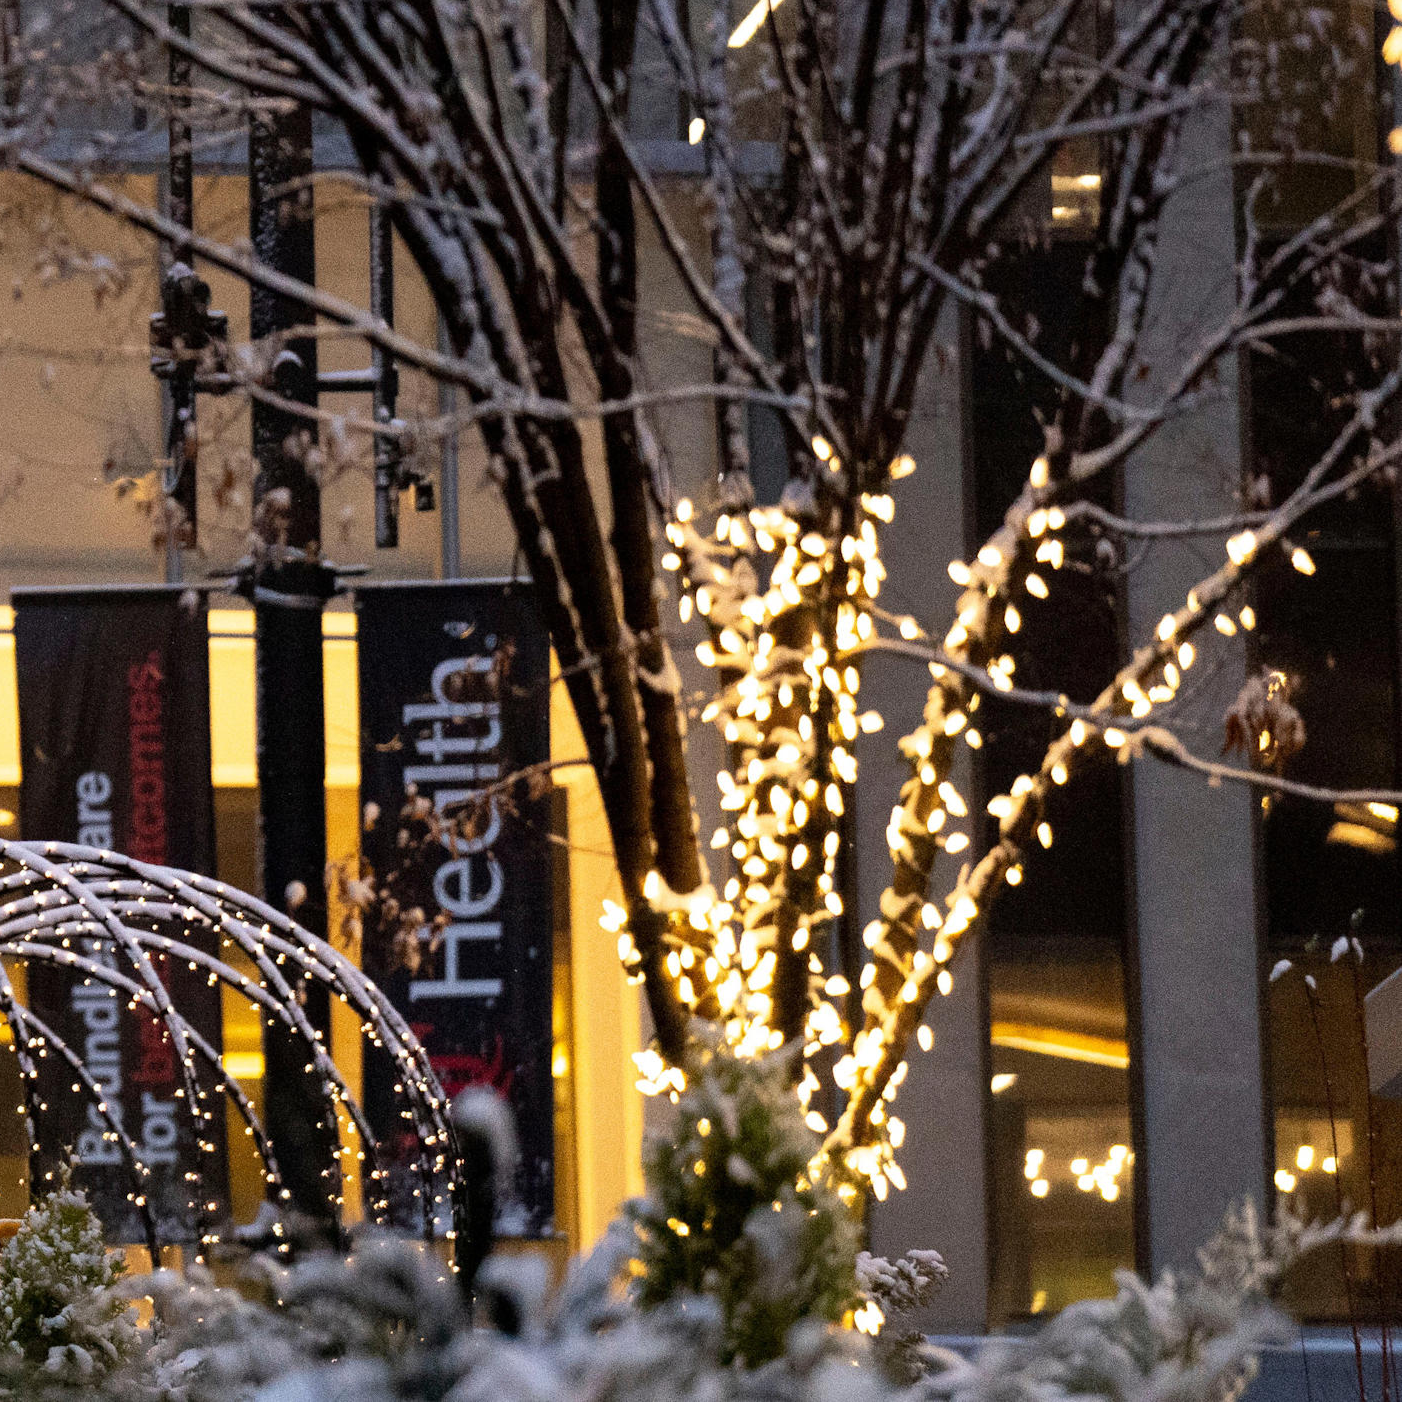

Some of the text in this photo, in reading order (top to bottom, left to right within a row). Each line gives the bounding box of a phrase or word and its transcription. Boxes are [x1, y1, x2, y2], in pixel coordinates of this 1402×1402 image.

[127, 648, 167, 918] tcomes.
[71, 769, 123, 1165] Boundls are
[132, 1089, 181, 1166] for
